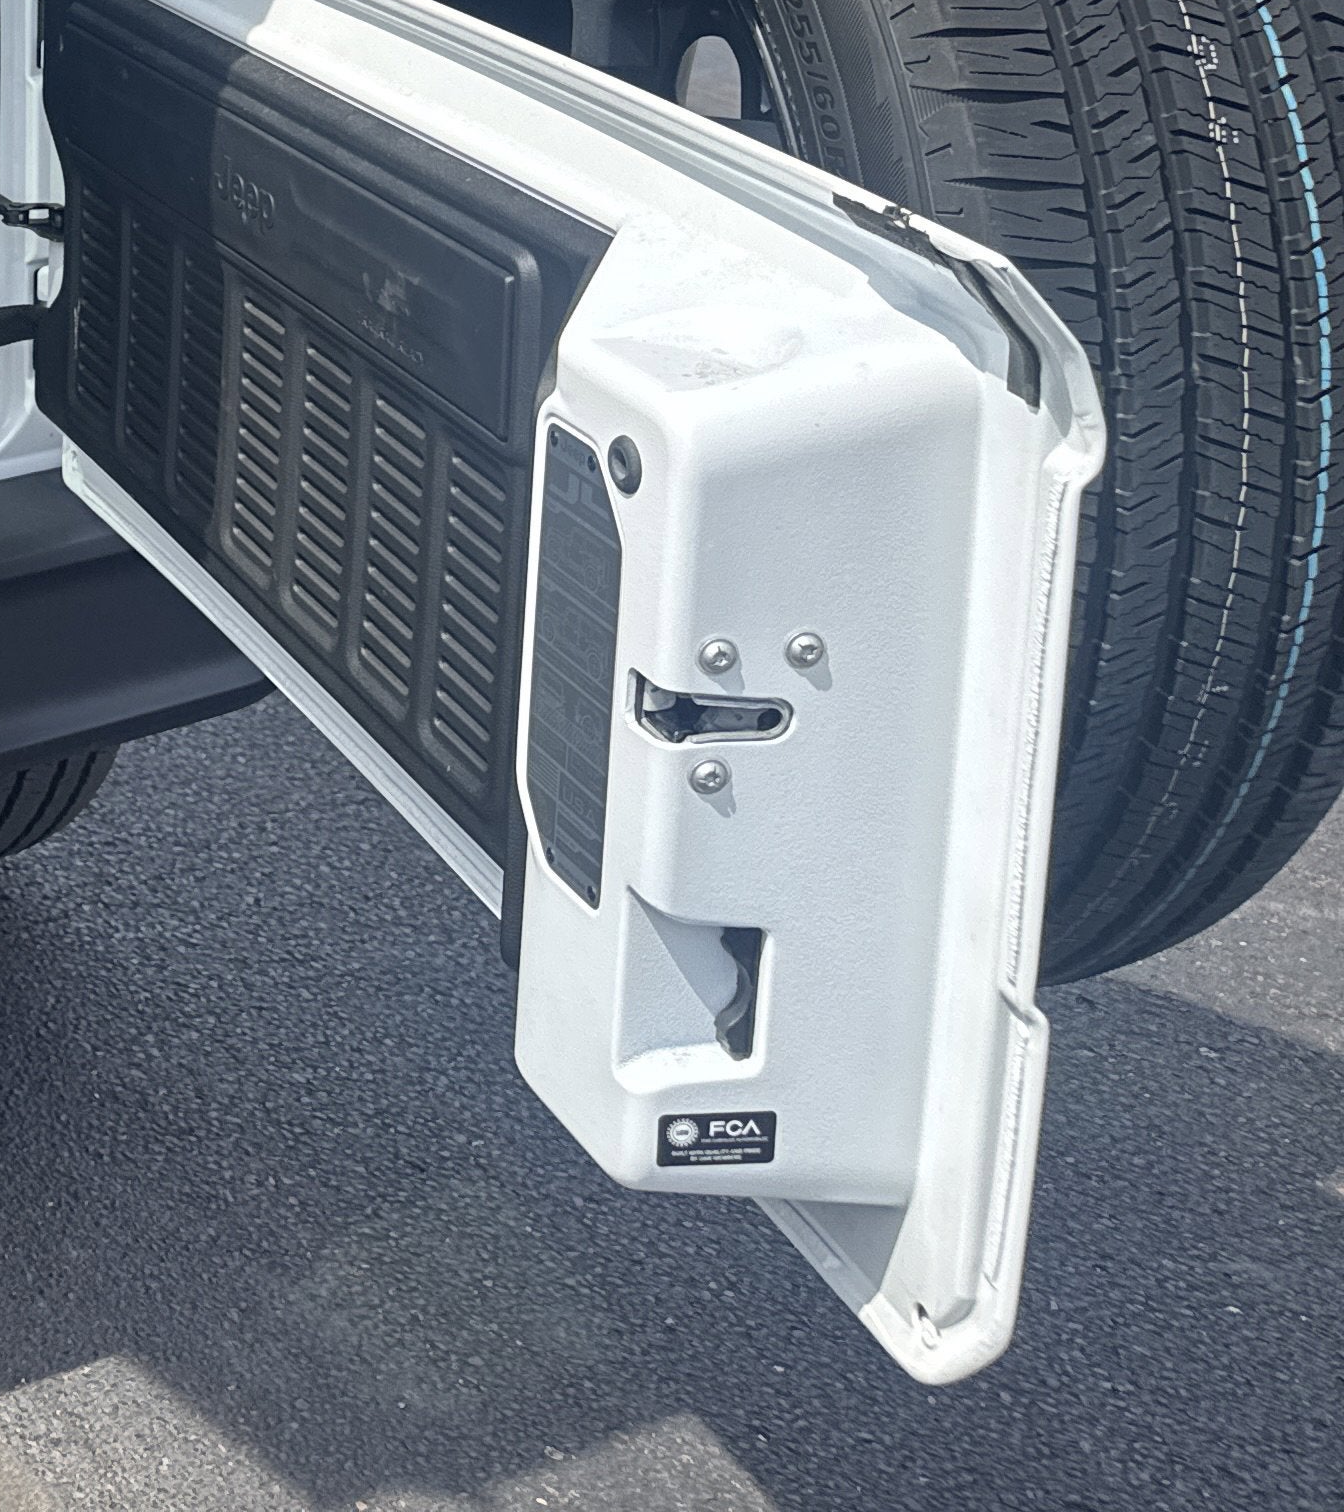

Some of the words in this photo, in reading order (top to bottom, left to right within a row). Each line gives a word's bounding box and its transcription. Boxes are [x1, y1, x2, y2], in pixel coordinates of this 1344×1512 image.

[214, 154, 276, 233] Jeep
[548, 472, 611, 523] JL
[562, 786, 598, 831] USA
[709, 1119, 762, 1137] FCA
